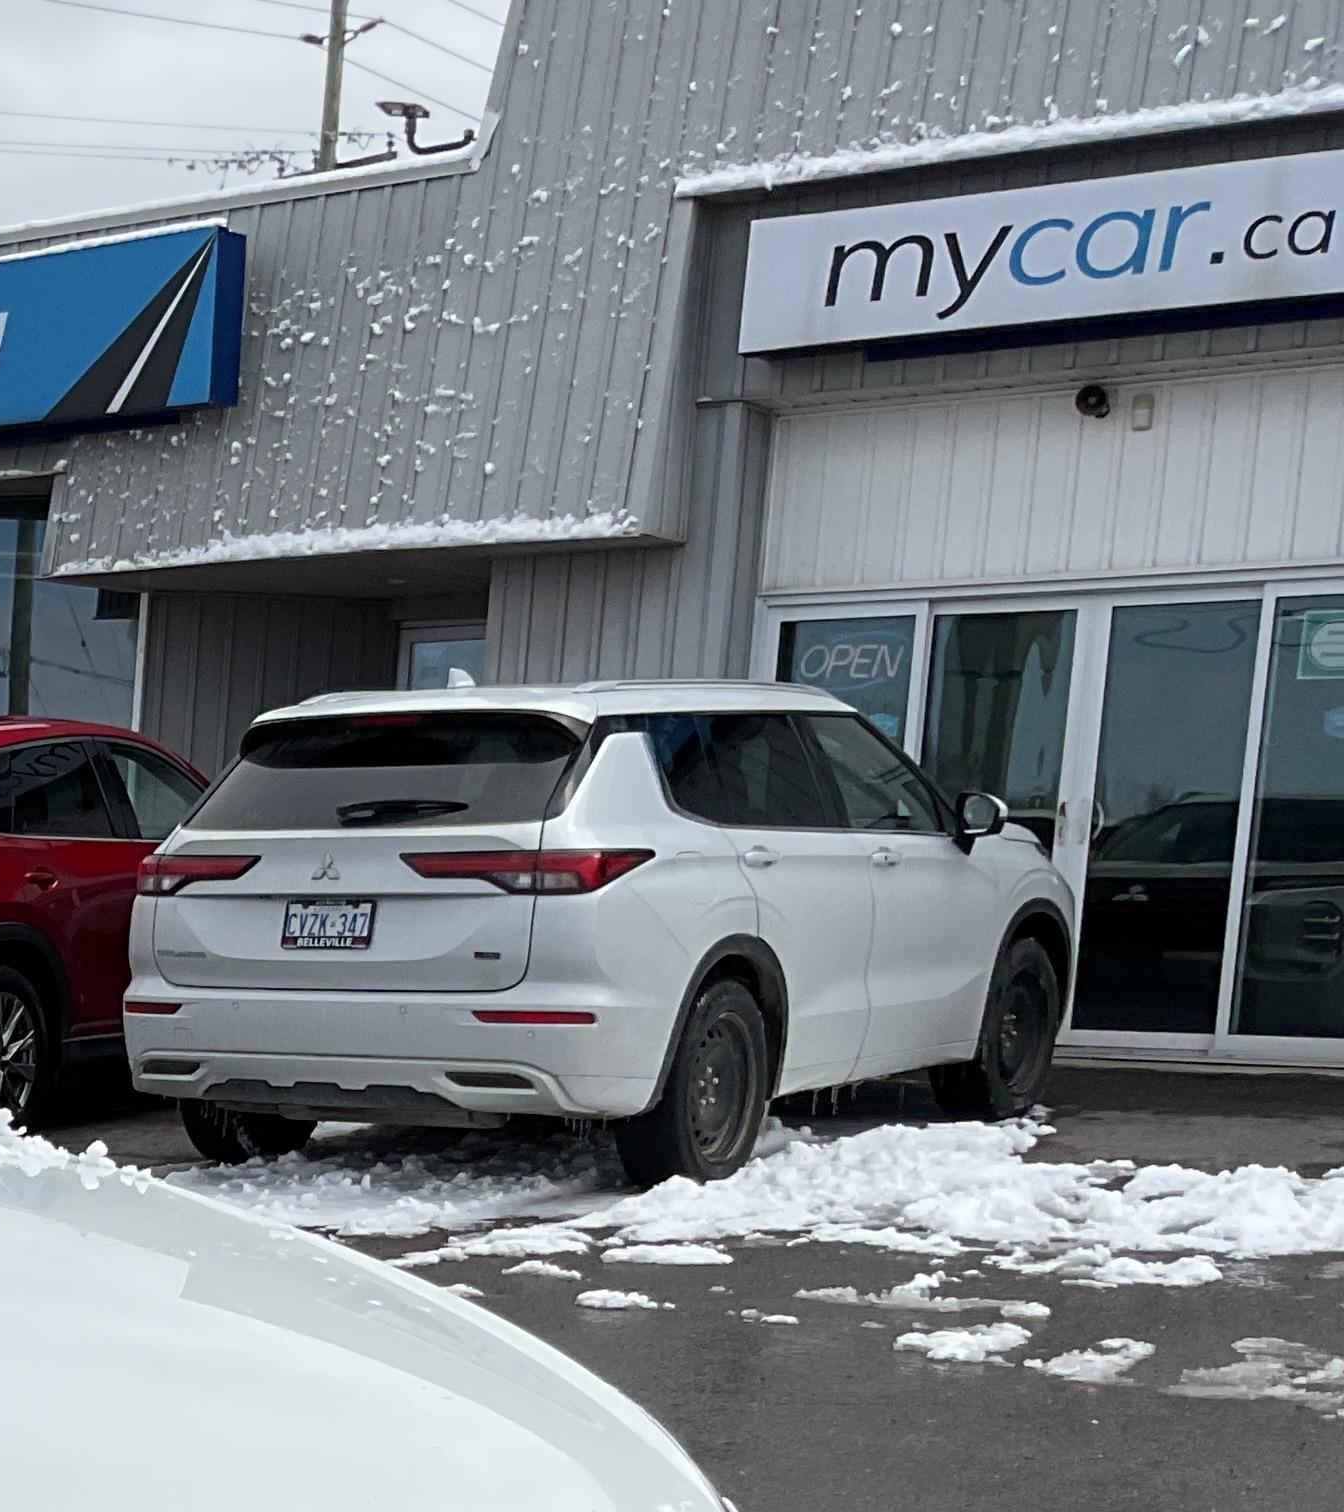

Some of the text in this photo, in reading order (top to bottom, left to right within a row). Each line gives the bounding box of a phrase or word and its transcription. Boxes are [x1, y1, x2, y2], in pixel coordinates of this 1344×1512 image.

[823, 200, 1337, 321] mycar.ca
[800, 644, 905, 679] OPEN
[296, 936, 353, 947] BELLEVILLE
